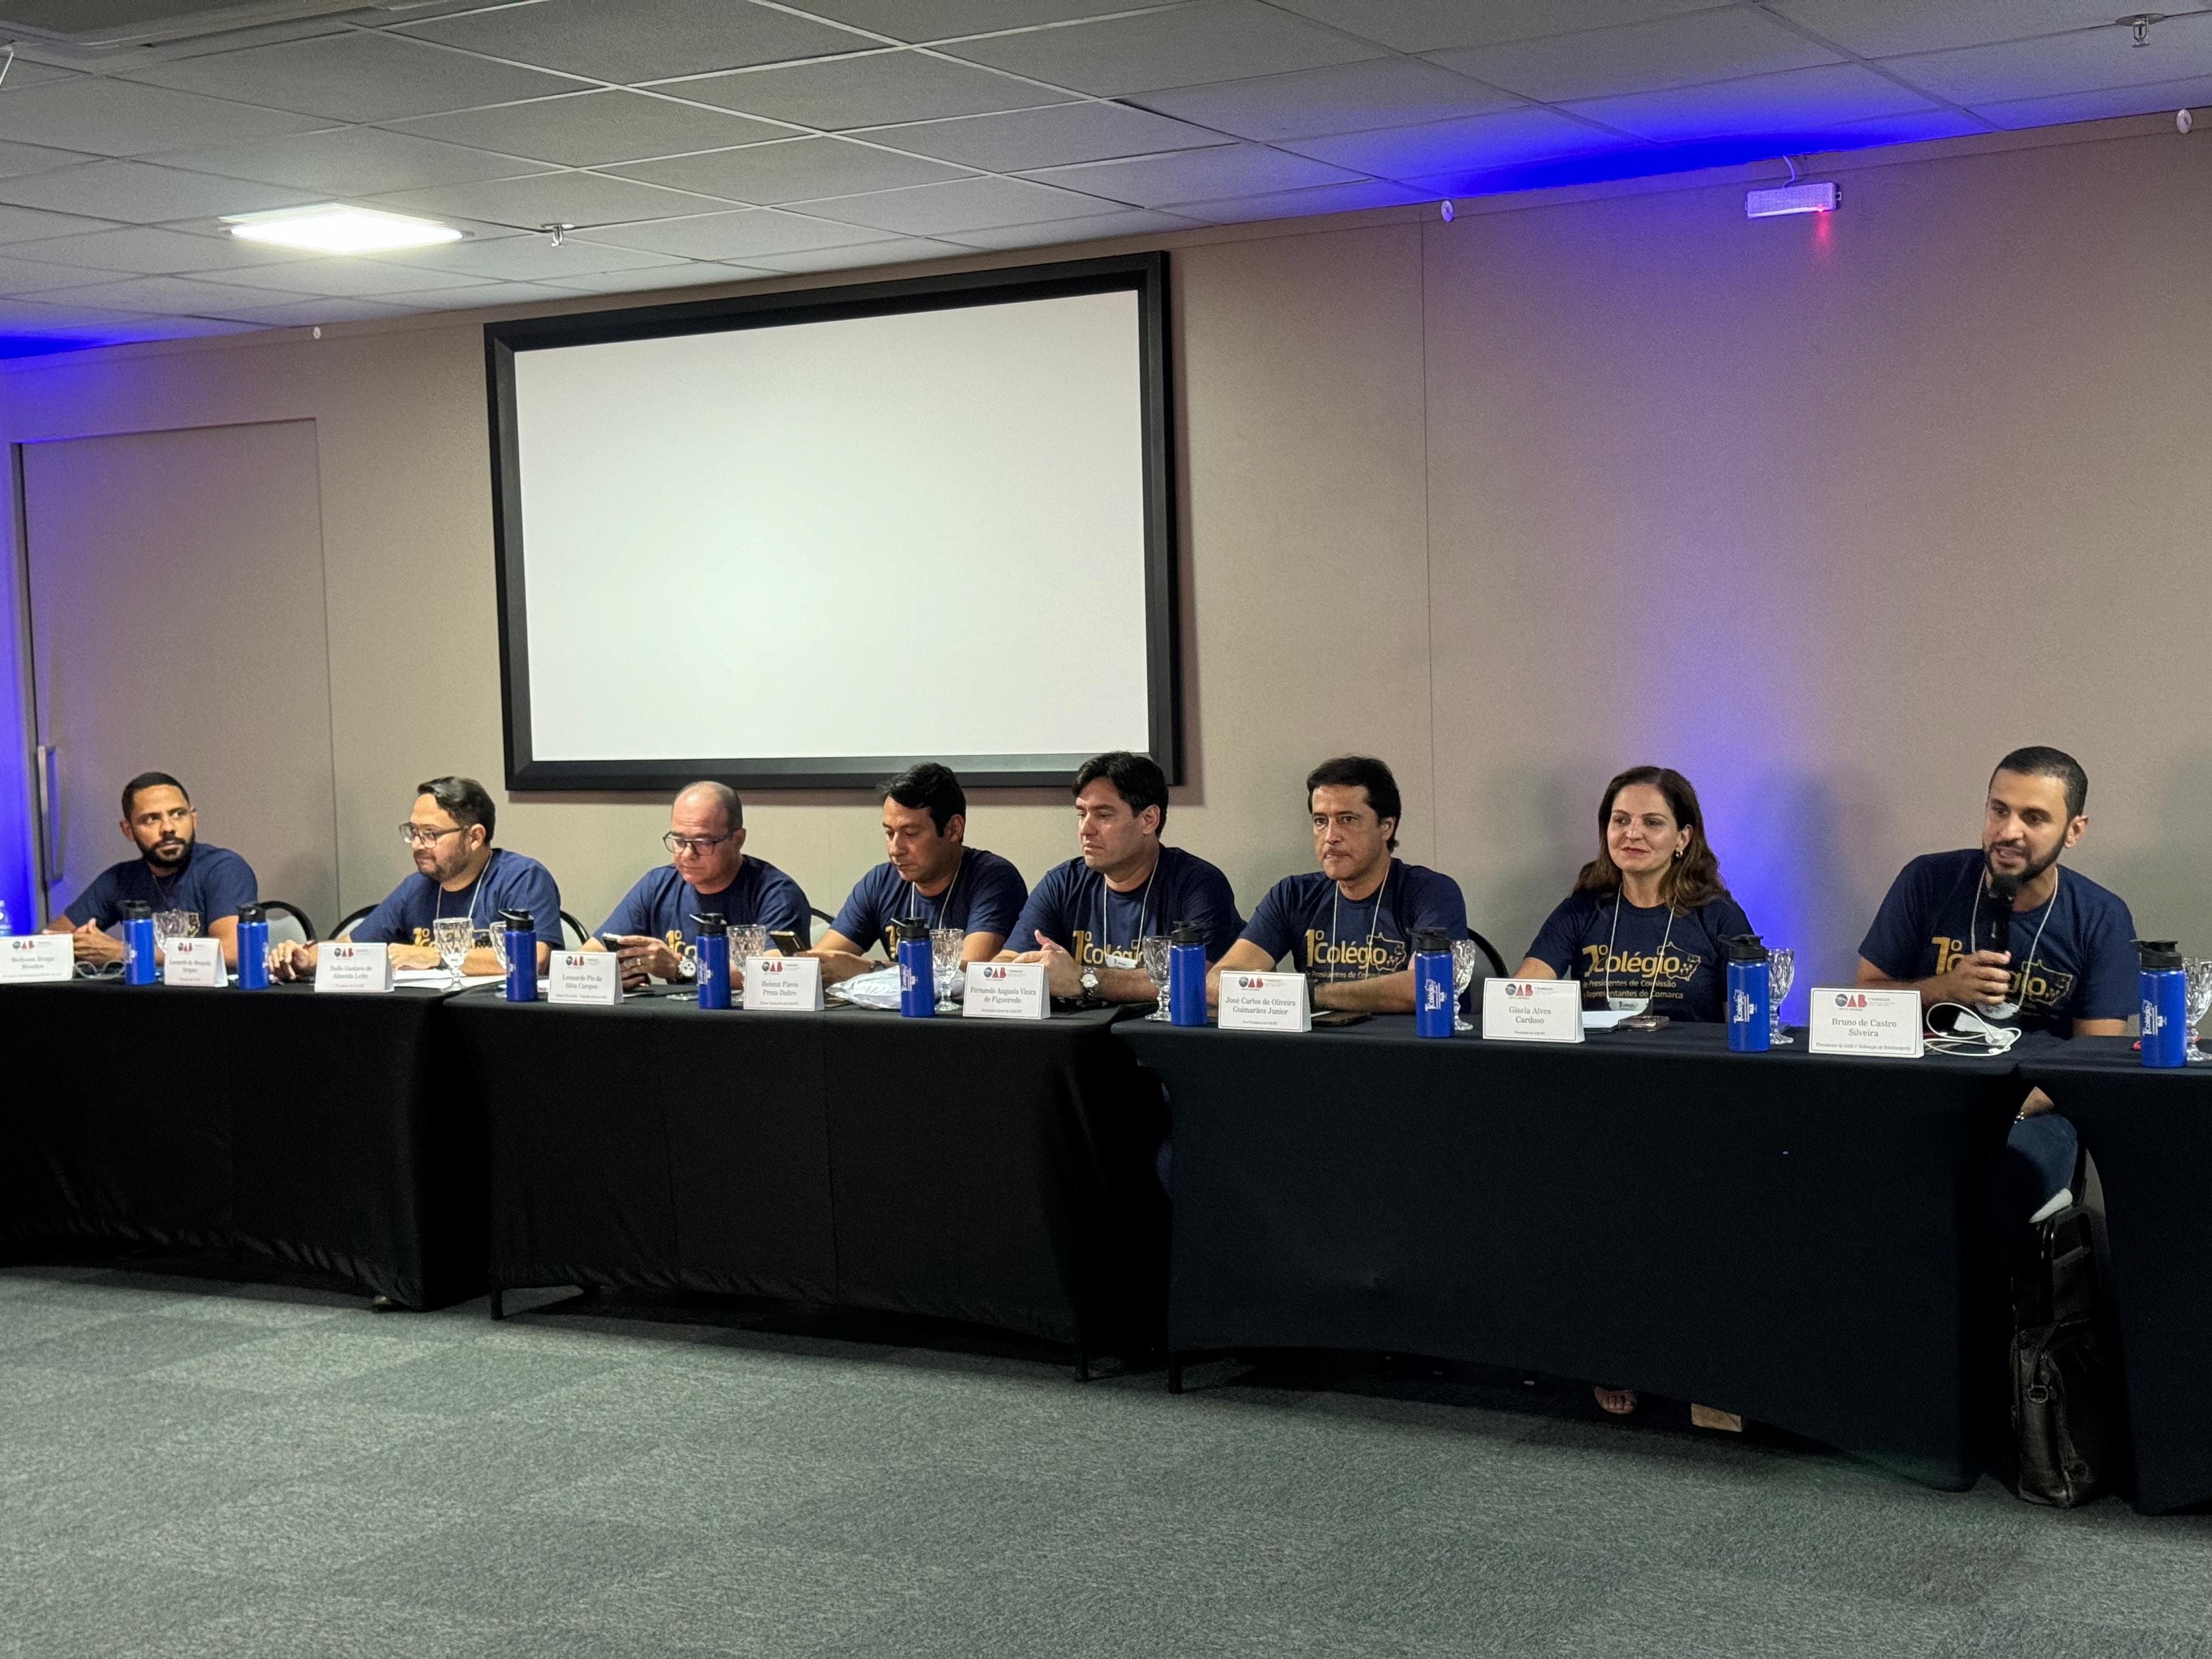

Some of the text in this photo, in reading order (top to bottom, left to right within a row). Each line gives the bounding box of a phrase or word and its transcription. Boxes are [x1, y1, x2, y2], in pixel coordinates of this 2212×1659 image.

[1314, 940, 1387, 969] Colégio
[1594, 951, 1680, 978] Colégio
[1509, 1006, 1531, 1014] Gisela
[1870, 1019, 1897, 1028] Castro
[1848, 1028, 1878, 1037] Silveira
